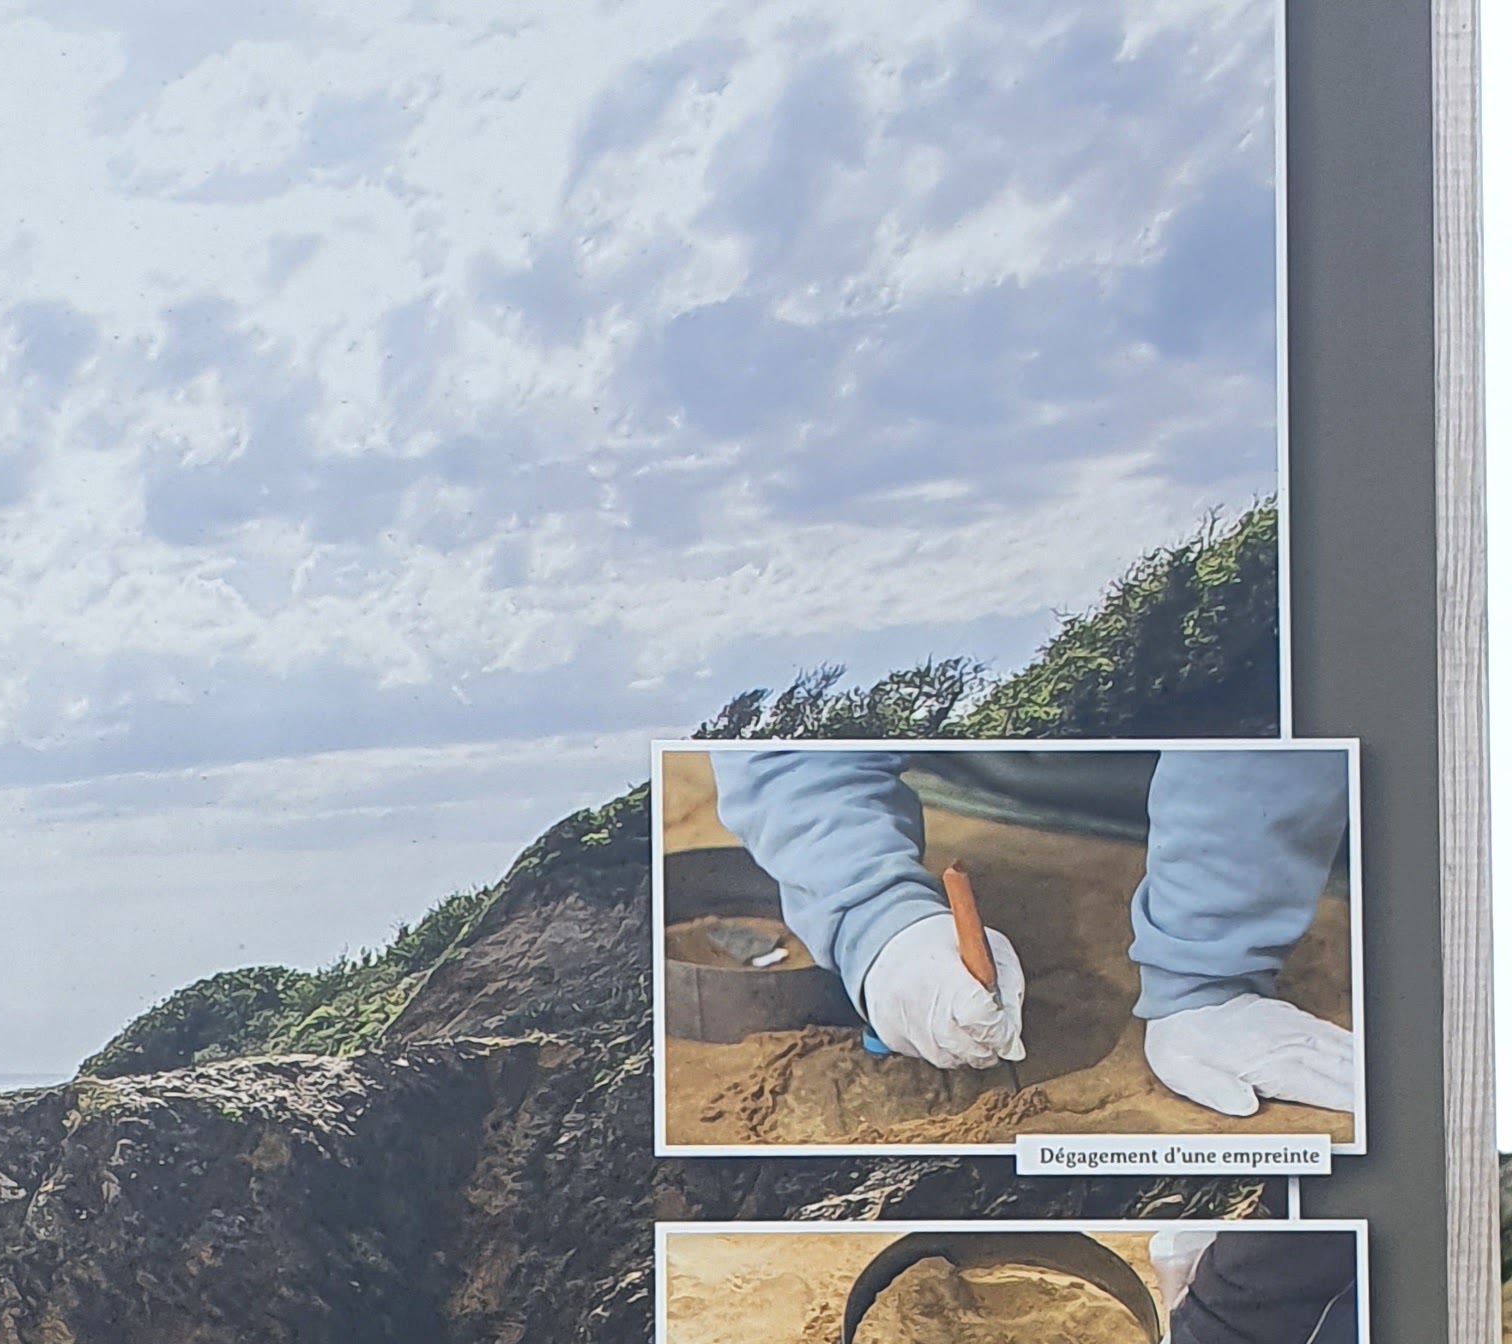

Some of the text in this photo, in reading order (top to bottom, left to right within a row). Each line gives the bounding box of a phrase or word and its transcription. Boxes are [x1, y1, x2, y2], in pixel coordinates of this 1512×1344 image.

[1040, 1146, 1319, 1168] Dégagement d'une empreinte
